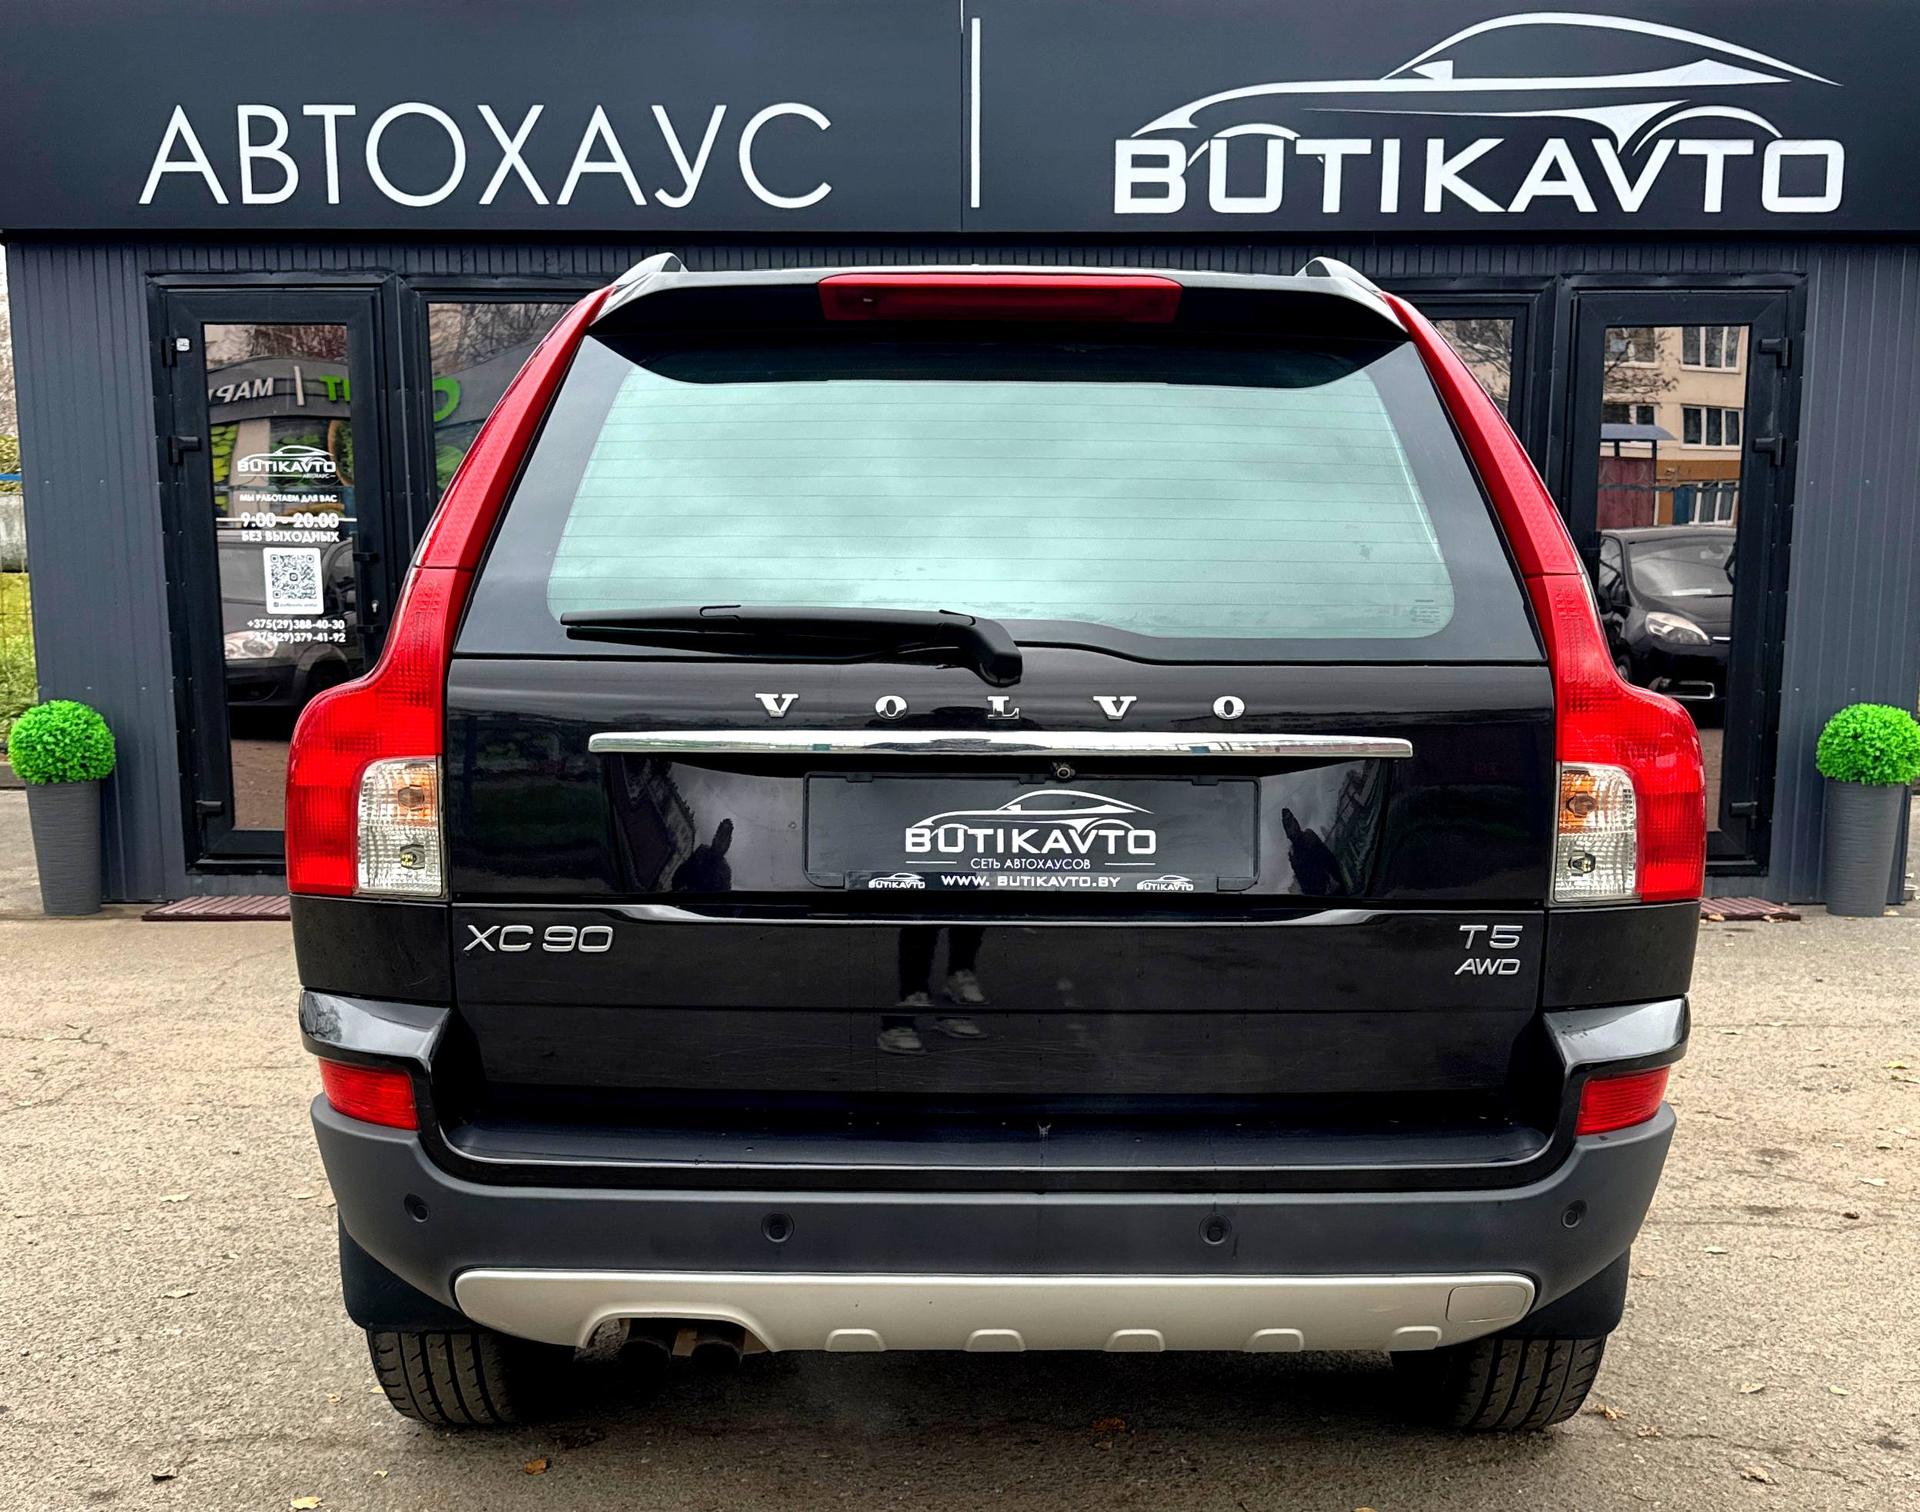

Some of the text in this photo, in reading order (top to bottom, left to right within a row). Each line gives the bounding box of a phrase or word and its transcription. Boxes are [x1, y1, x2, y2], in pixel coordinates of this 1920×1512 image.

[138, 102, 832, 208] АВТОХАУС
[1113, 138, 1845, 214] BUTIKAVTO
[237, 460, 336, 473] BUTIKAVTO
[239, 493, 255, 502] МЫ
[256, 493, 300, 502] РАБОТАЕМ
[319, 494, 338, 503] ВАС
[240, 512, 277, 528] 9:00
[292, 512, 340, 529] 20:00
[241, 530, 340, 543] БЕЗ ВЫХОДНЫХ
[754, 692, 1247, 720] VOLVO
[904, 827, 1157, 855] BUTIKAVTO
[970, 857, 1092, 870] СЕТЬ АВТОХАУСОВ
[868, 881, 926, 889] BUTIKAVTO
[1136, 882, 1194, 891] BUTIKAVTO
[1459, 924, 1524, 950] T5
[1454, 958, 1521, 976] AWD
